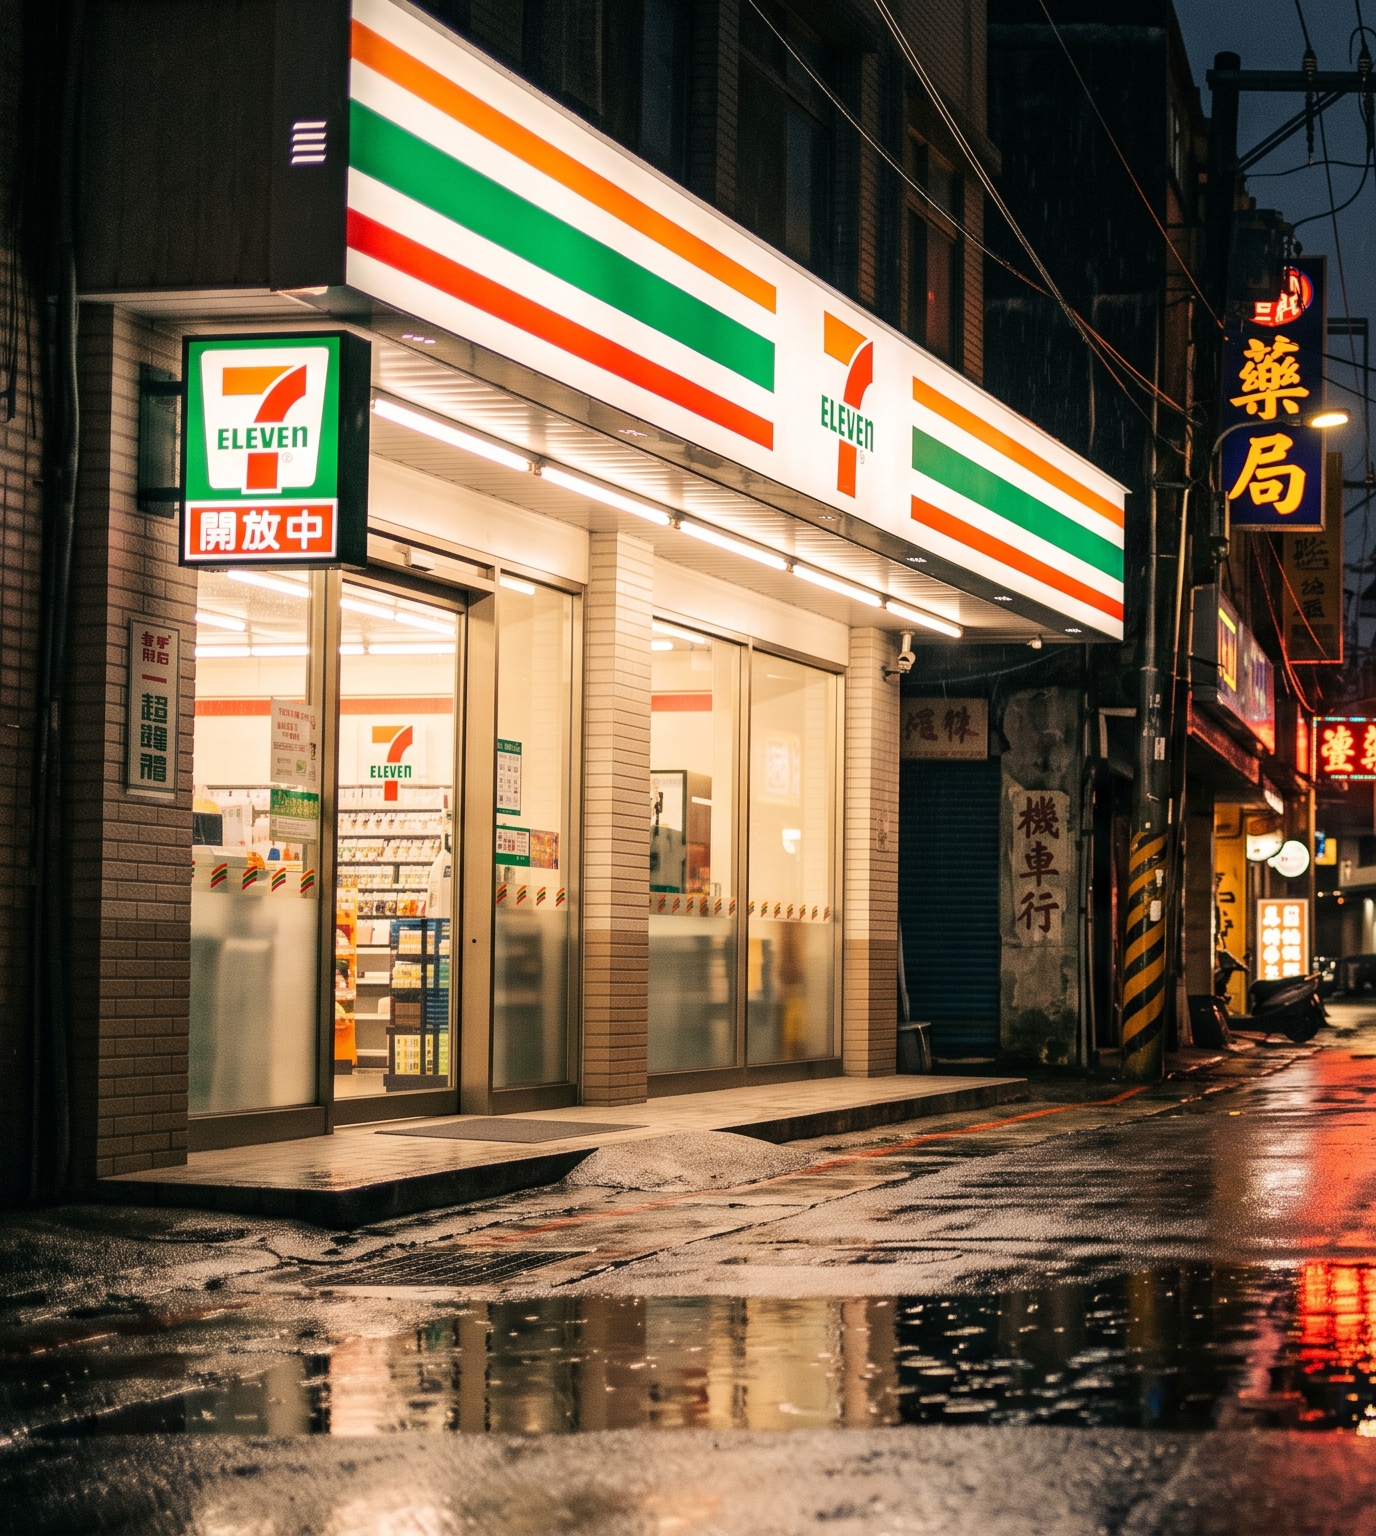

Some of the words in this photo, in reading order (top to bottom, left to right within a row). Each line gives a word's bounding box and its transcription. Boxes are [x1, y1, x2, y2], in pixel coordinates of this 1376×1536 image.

[1229, 335, 1310, 515] 藥局
[200, 509, 323, 551] 開放中
[1017, 795, 1060, 934] 機車行
